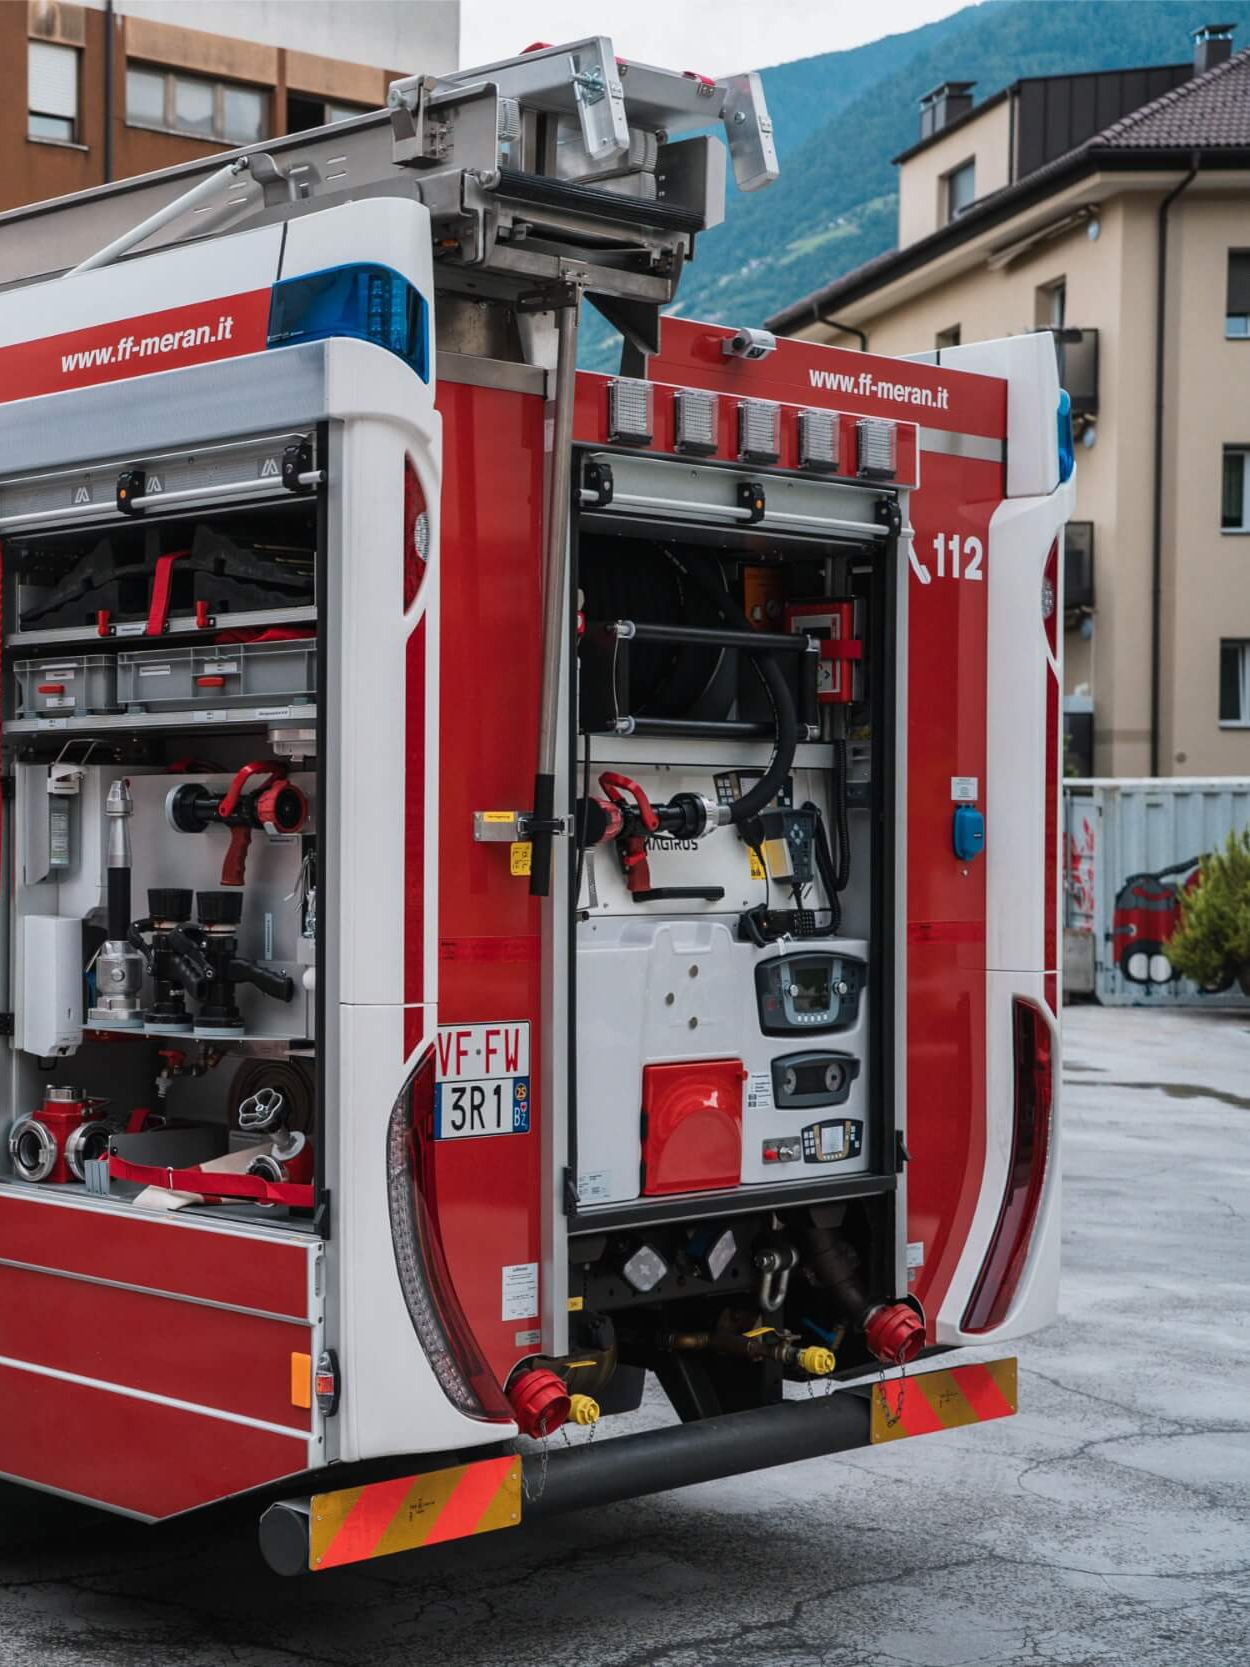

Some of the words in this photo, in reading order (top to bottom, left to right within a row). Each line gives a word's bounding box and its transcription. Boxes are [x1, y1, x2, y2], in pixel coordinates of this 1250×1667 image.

[62, 316, 233, 372] www.ff-meran.it
[808, 369, 949, 410] www.ff-meran.it
[933, 532, 983, 581] 112
[450, 1083, 502, 1131] 3R1
